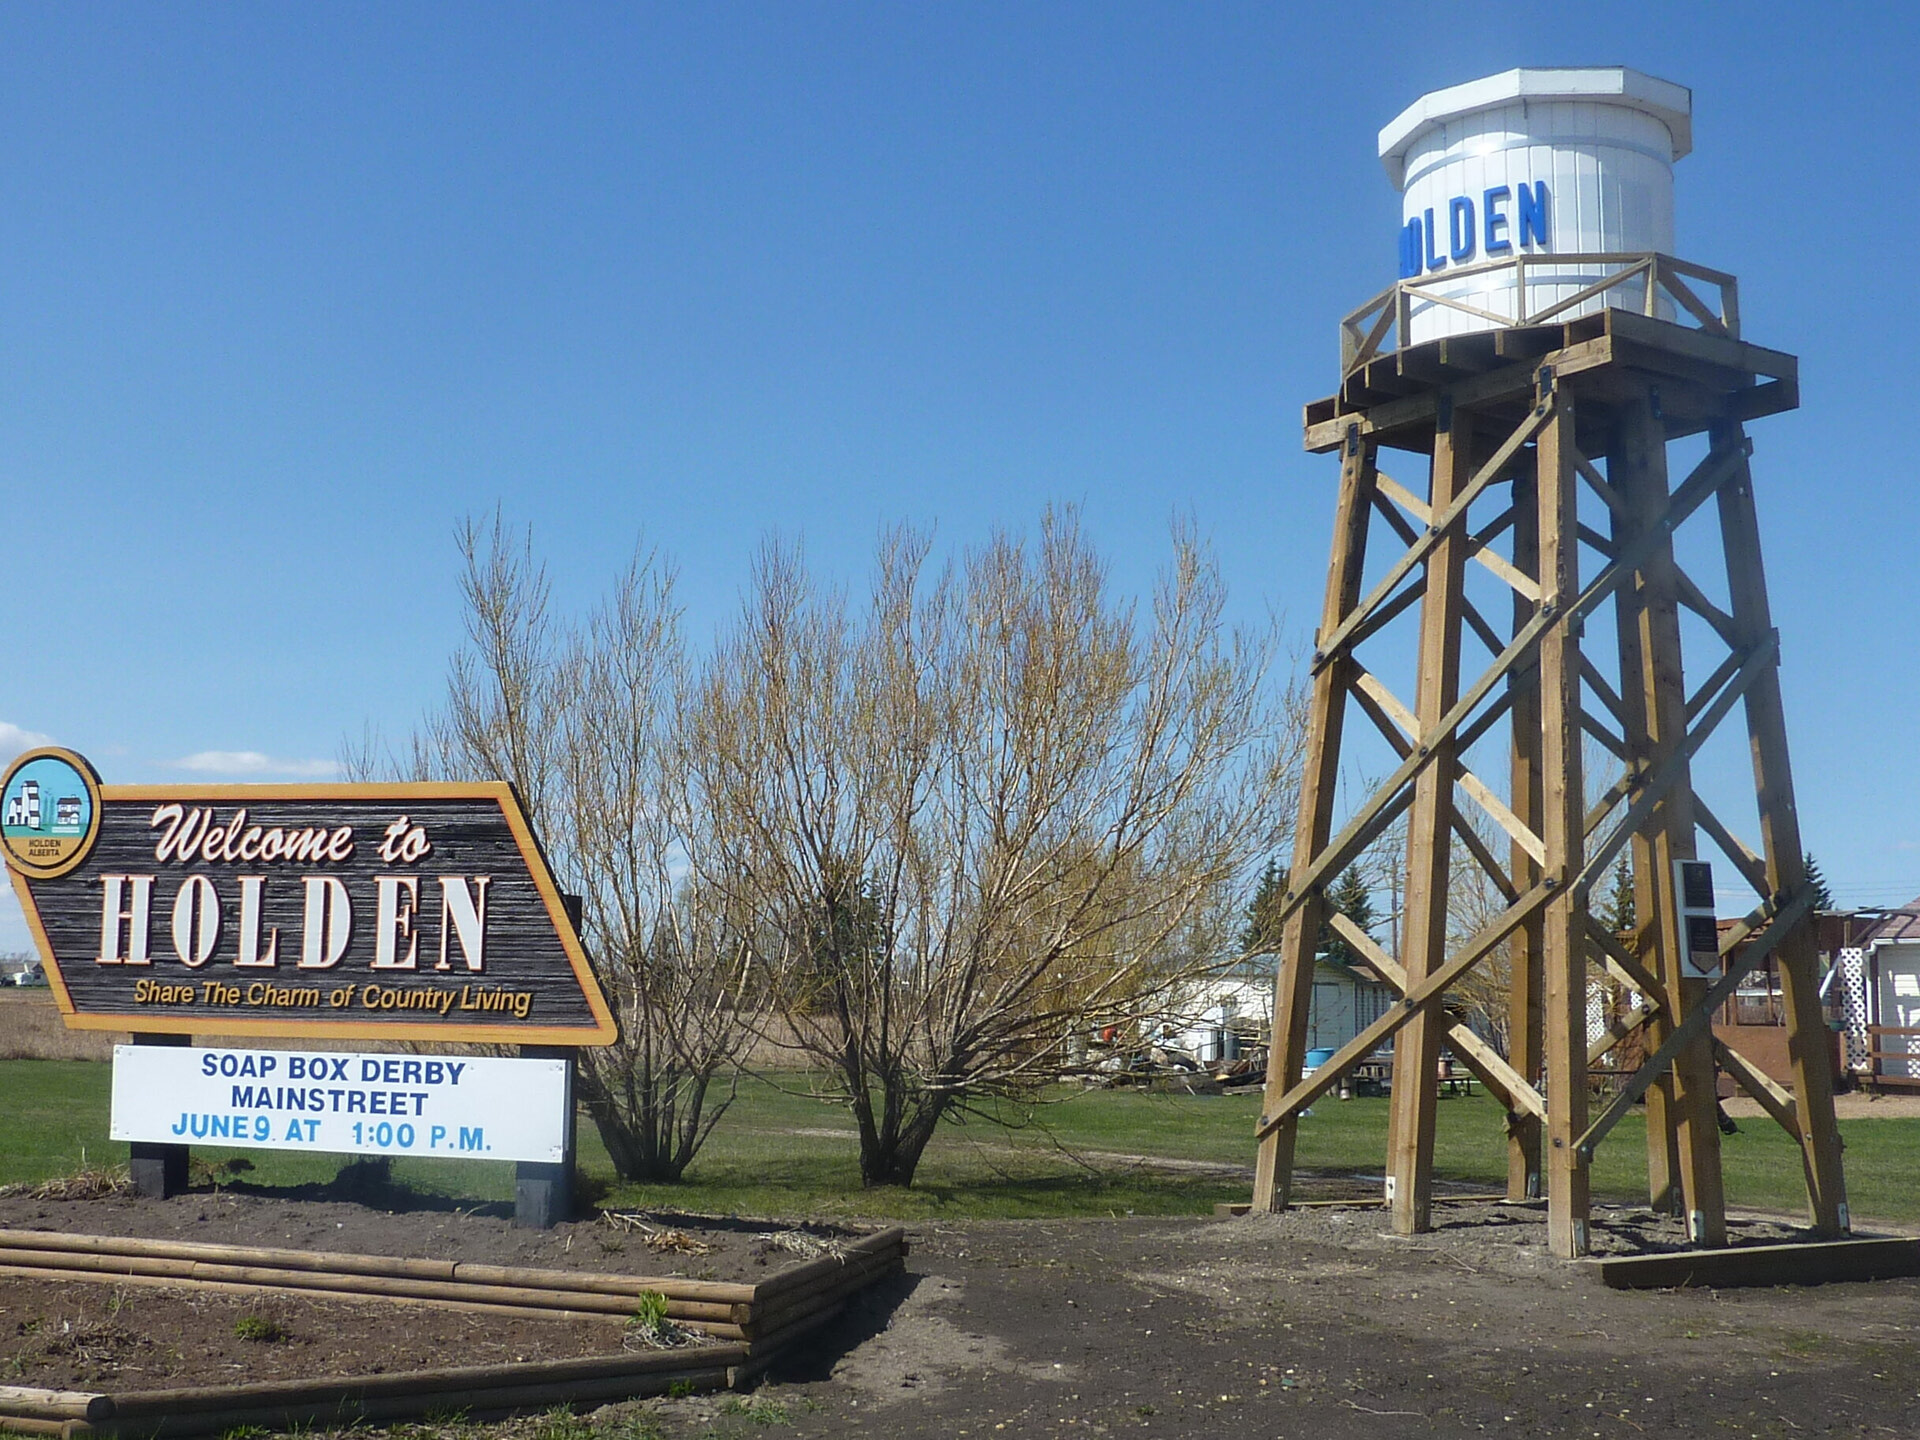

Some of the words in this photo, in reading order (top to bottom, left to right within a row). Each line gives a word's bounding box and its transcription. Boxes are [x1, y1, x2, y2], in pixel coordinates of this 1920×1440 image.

[1398, 180, 1547, 280] OLDEN
[28, 839, 61, 847] HOLDEN
[151, 803, 354, 863] Welcome
[377, 814, 432, 863] to
[28, 848, 59, 856] ALBERTA
[95, 873, 492, 971] HOLDEN
[134, 979, 194, 1004] Share
[202, 981, 241, 1005] The
[247, 982, 320, 1007] Charm
[330, 983, 354, 1008] of
[361, 984, 456, 1014] Country
[460, 985, 532, 1018] Living
[201, 1053, 276, 1079] SOAP
[289, 1057, 349, 1081] BOX
[361, 1059, 466, 1085] DERBY
[231, 1085, 429, 1116] MAINSTREET
[285, 1119, 321, 1142] AT
[352, 1121, 415, 1148] 1:00
[430, 1126, 492, 1151] P.M.
